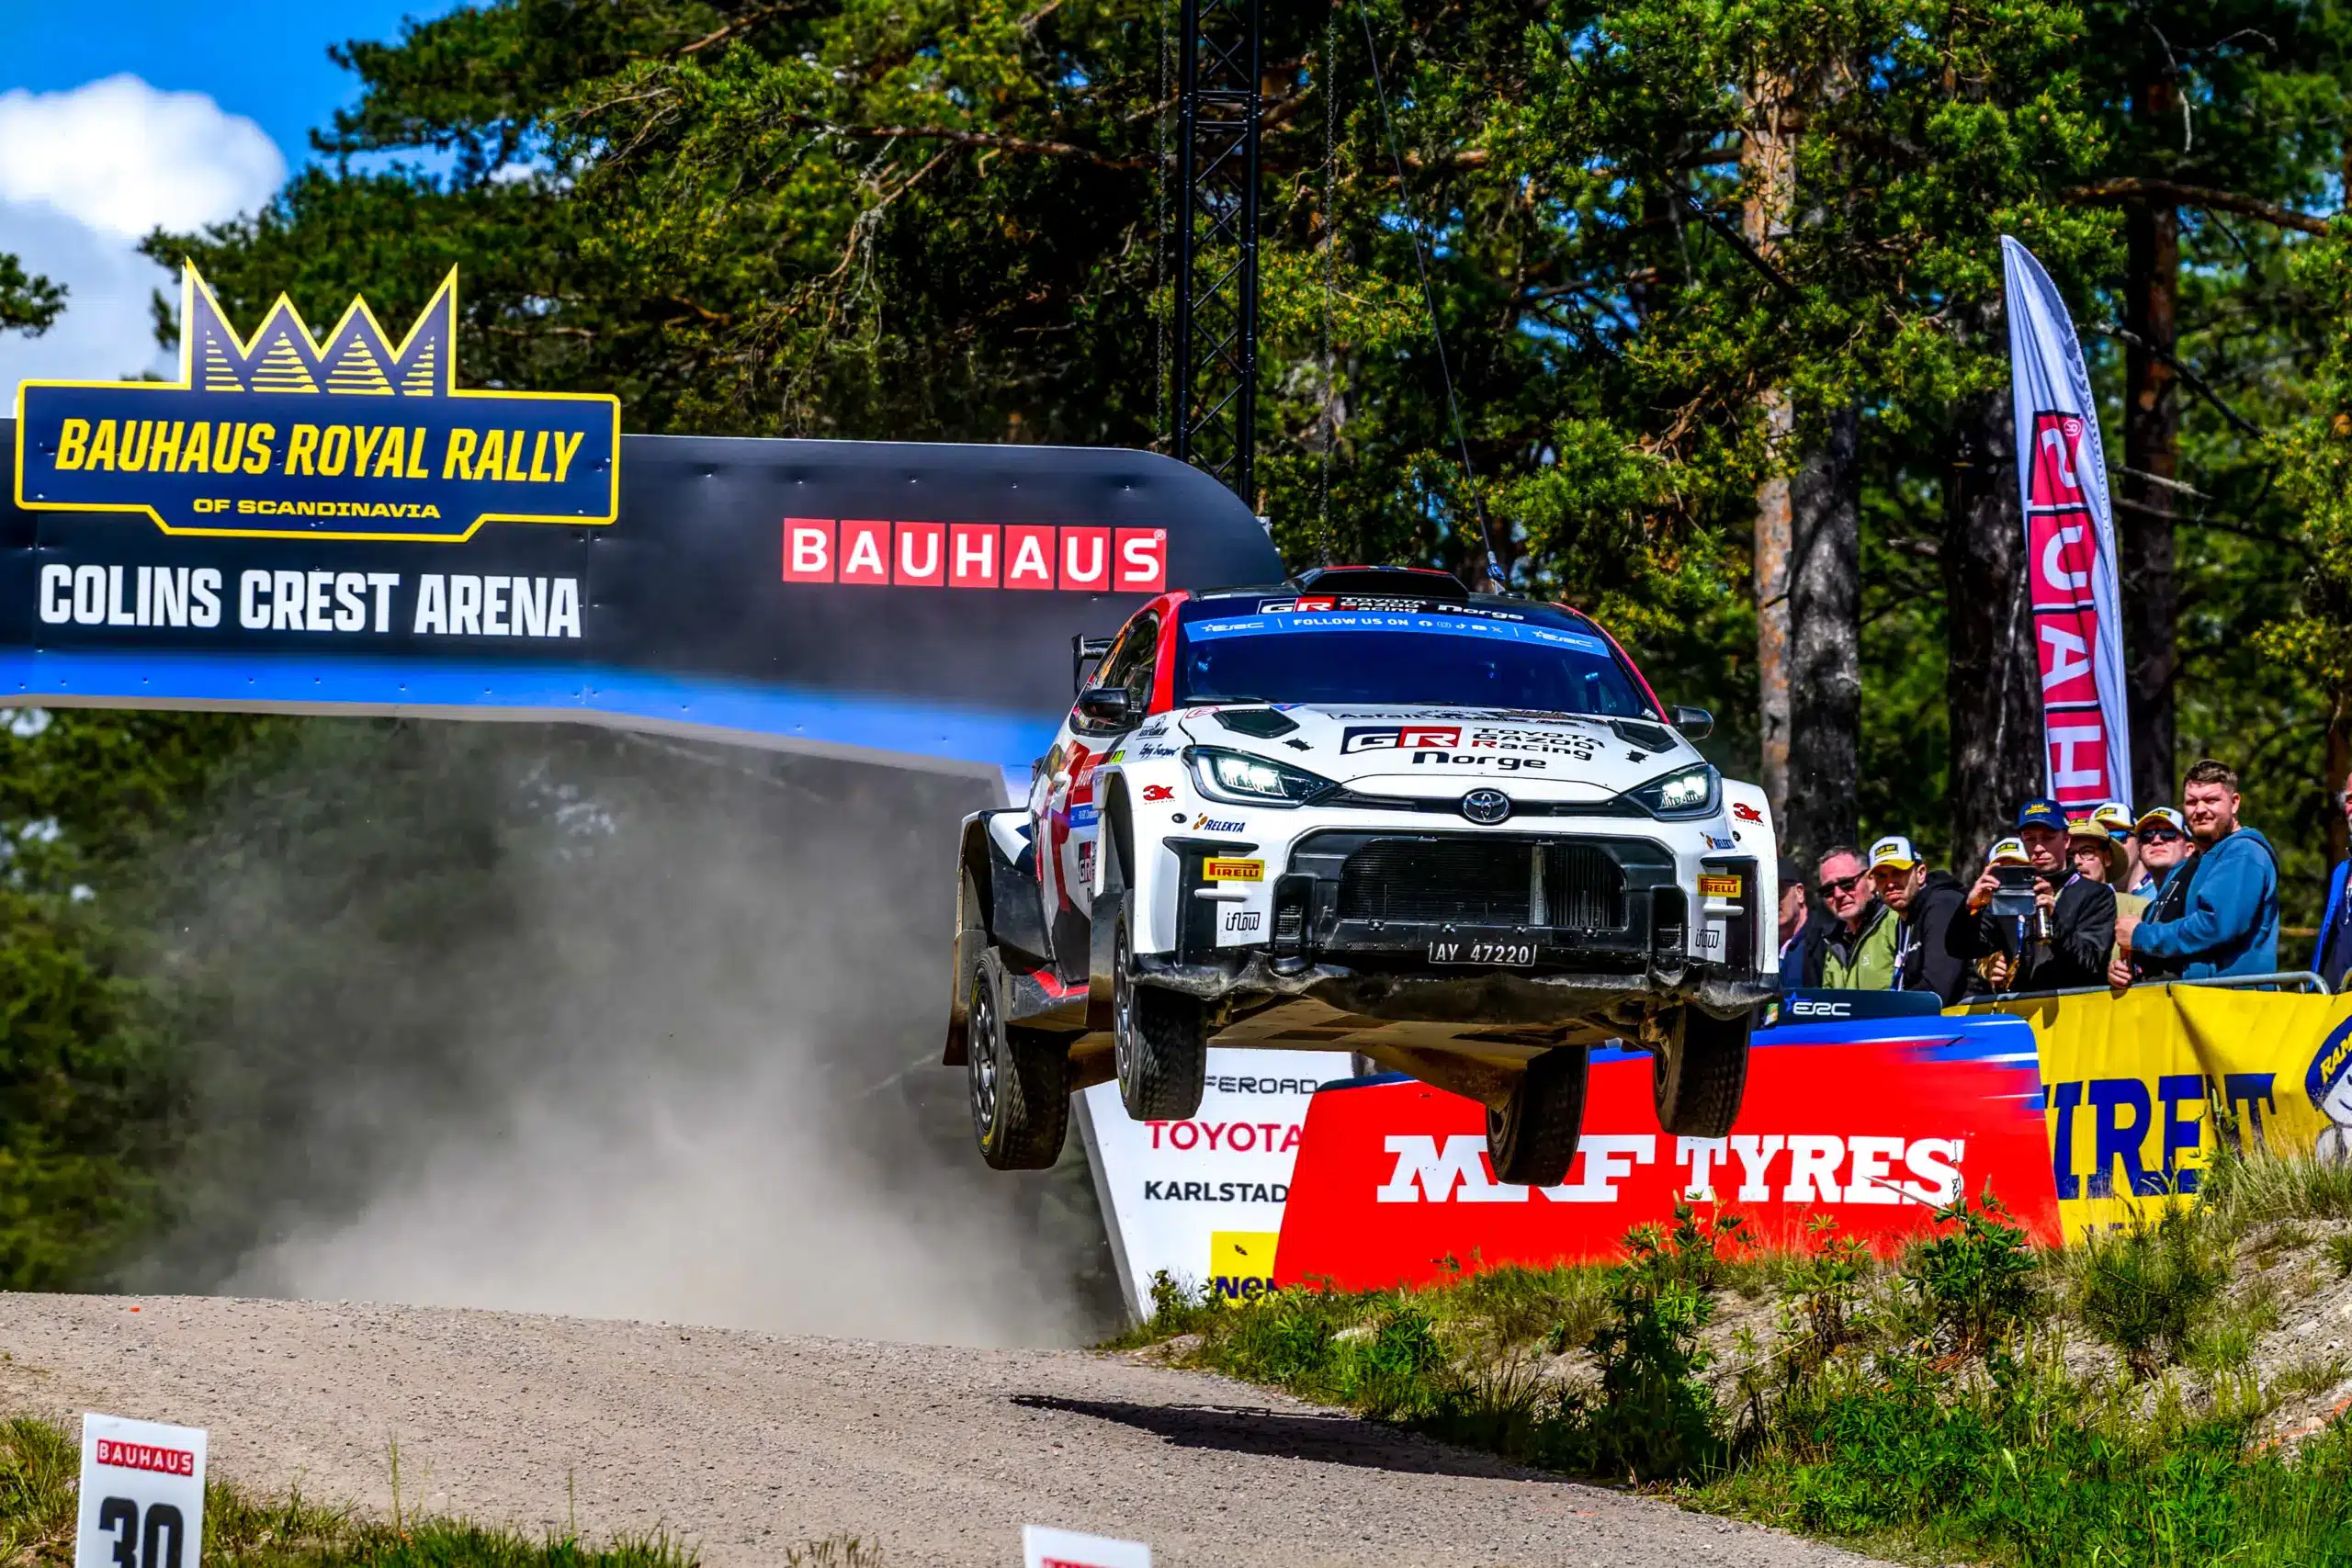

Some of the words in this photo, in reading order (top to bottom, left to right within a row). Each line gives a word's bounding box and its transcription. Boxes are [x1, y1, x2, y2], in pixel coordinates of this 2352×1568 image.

[55, 419, 275, 475] BAUHAUS
[283, 423, 429, 479] ROYAL
[442, 428, 584, 482] RALLY
[193, 499, 232, 513] OF
[237, 500, 441, 519] SCANDINAVIA
[792, 528, 1160, 582] BAUHAUS
[40, 564, 221, 628] COLINS
[240, 570, 400, 633] CREST
[413, 574, 582, 637] ARENA
[1261, 602, 1331, 614] GR
[1341, 597, 1427, 605] TOYOTA
[1344, 730, 1460, 753] GR
[1472, 733, 1594, 750] GAZOO
[1474, 728, 1605, 748] TOYOTA
[1471, 739, 1592, 761] Racing
[1204, 819, 1246, 833] RELEKTA
[1209, 862, 1260, 877] PIRELLI
[1701, 877, 1737, 893] PIRELLI
[1435, 944, 1459, 962] AY
[1470, 944, 1530, 964] 47220
[1145, 1120, 1305, 1153] TOYOTA
[1377, 1134, 1656, 1202] MF
[1675, 1134, 1965, 1207] TYRES
[1145, 1180, 1290, 1203] KARLSTAD
[98, 1441, 193, 1472] BAUHAUS
[99, 1495, 184, 1568] 30
